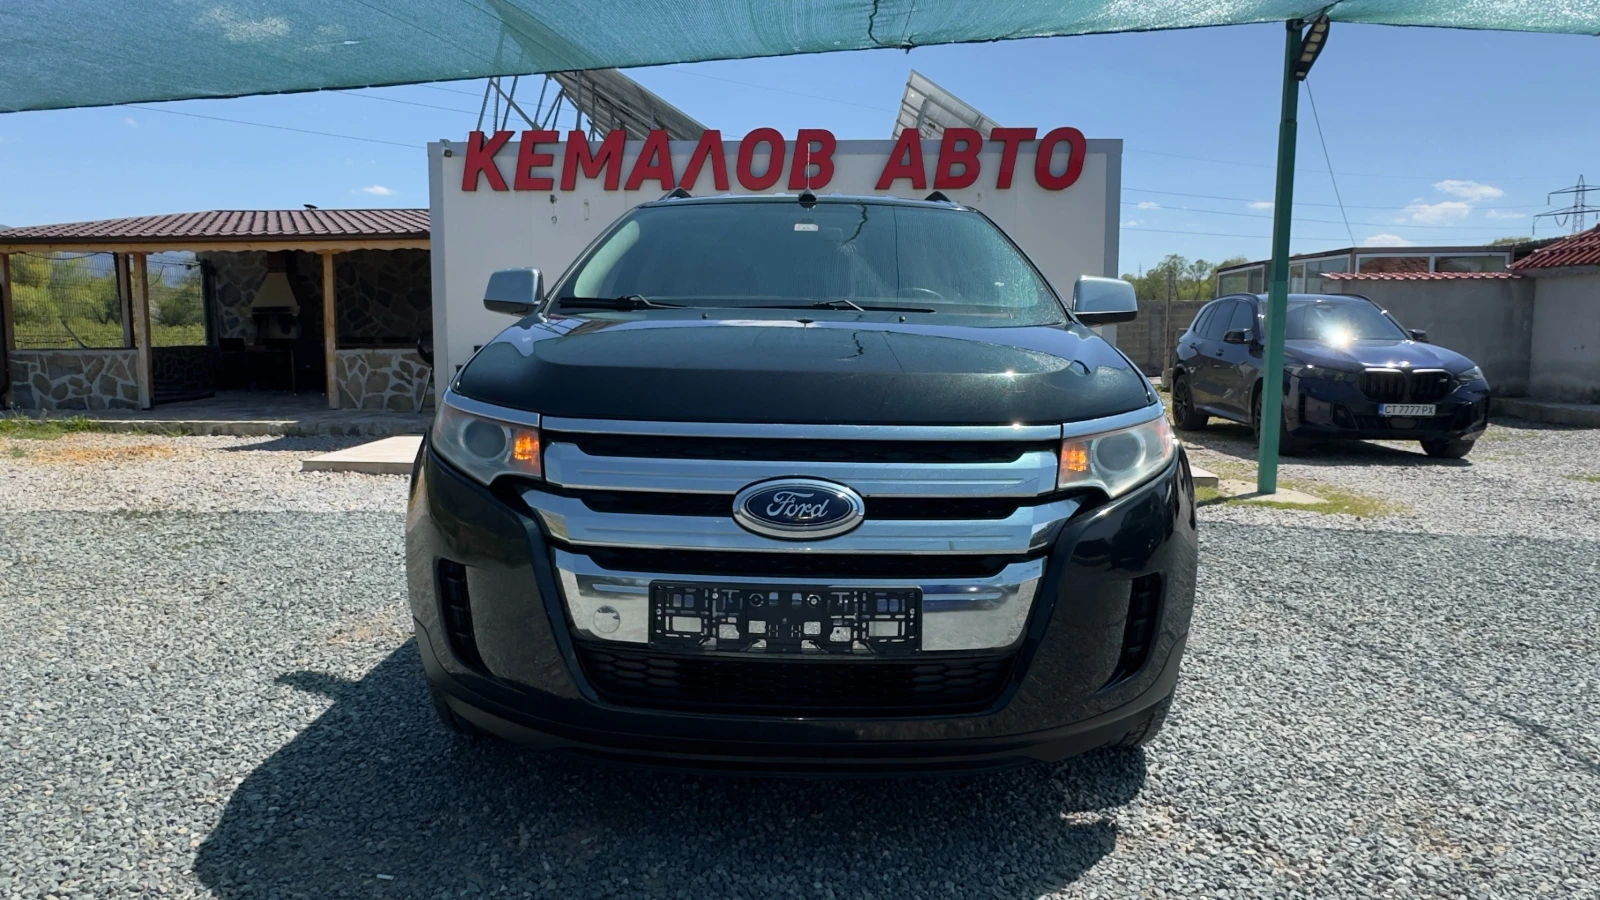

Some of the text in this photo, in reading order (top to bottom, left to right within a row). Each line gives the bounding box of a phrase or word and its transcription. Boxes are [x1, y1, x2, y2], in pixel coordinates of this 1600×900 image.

[462, 126, 1087, 191] КЕМАЛОВ АВТО
[1384, 405, 1434, 415] CT 7777 PX
[766, 491, 830, 517] Ford
